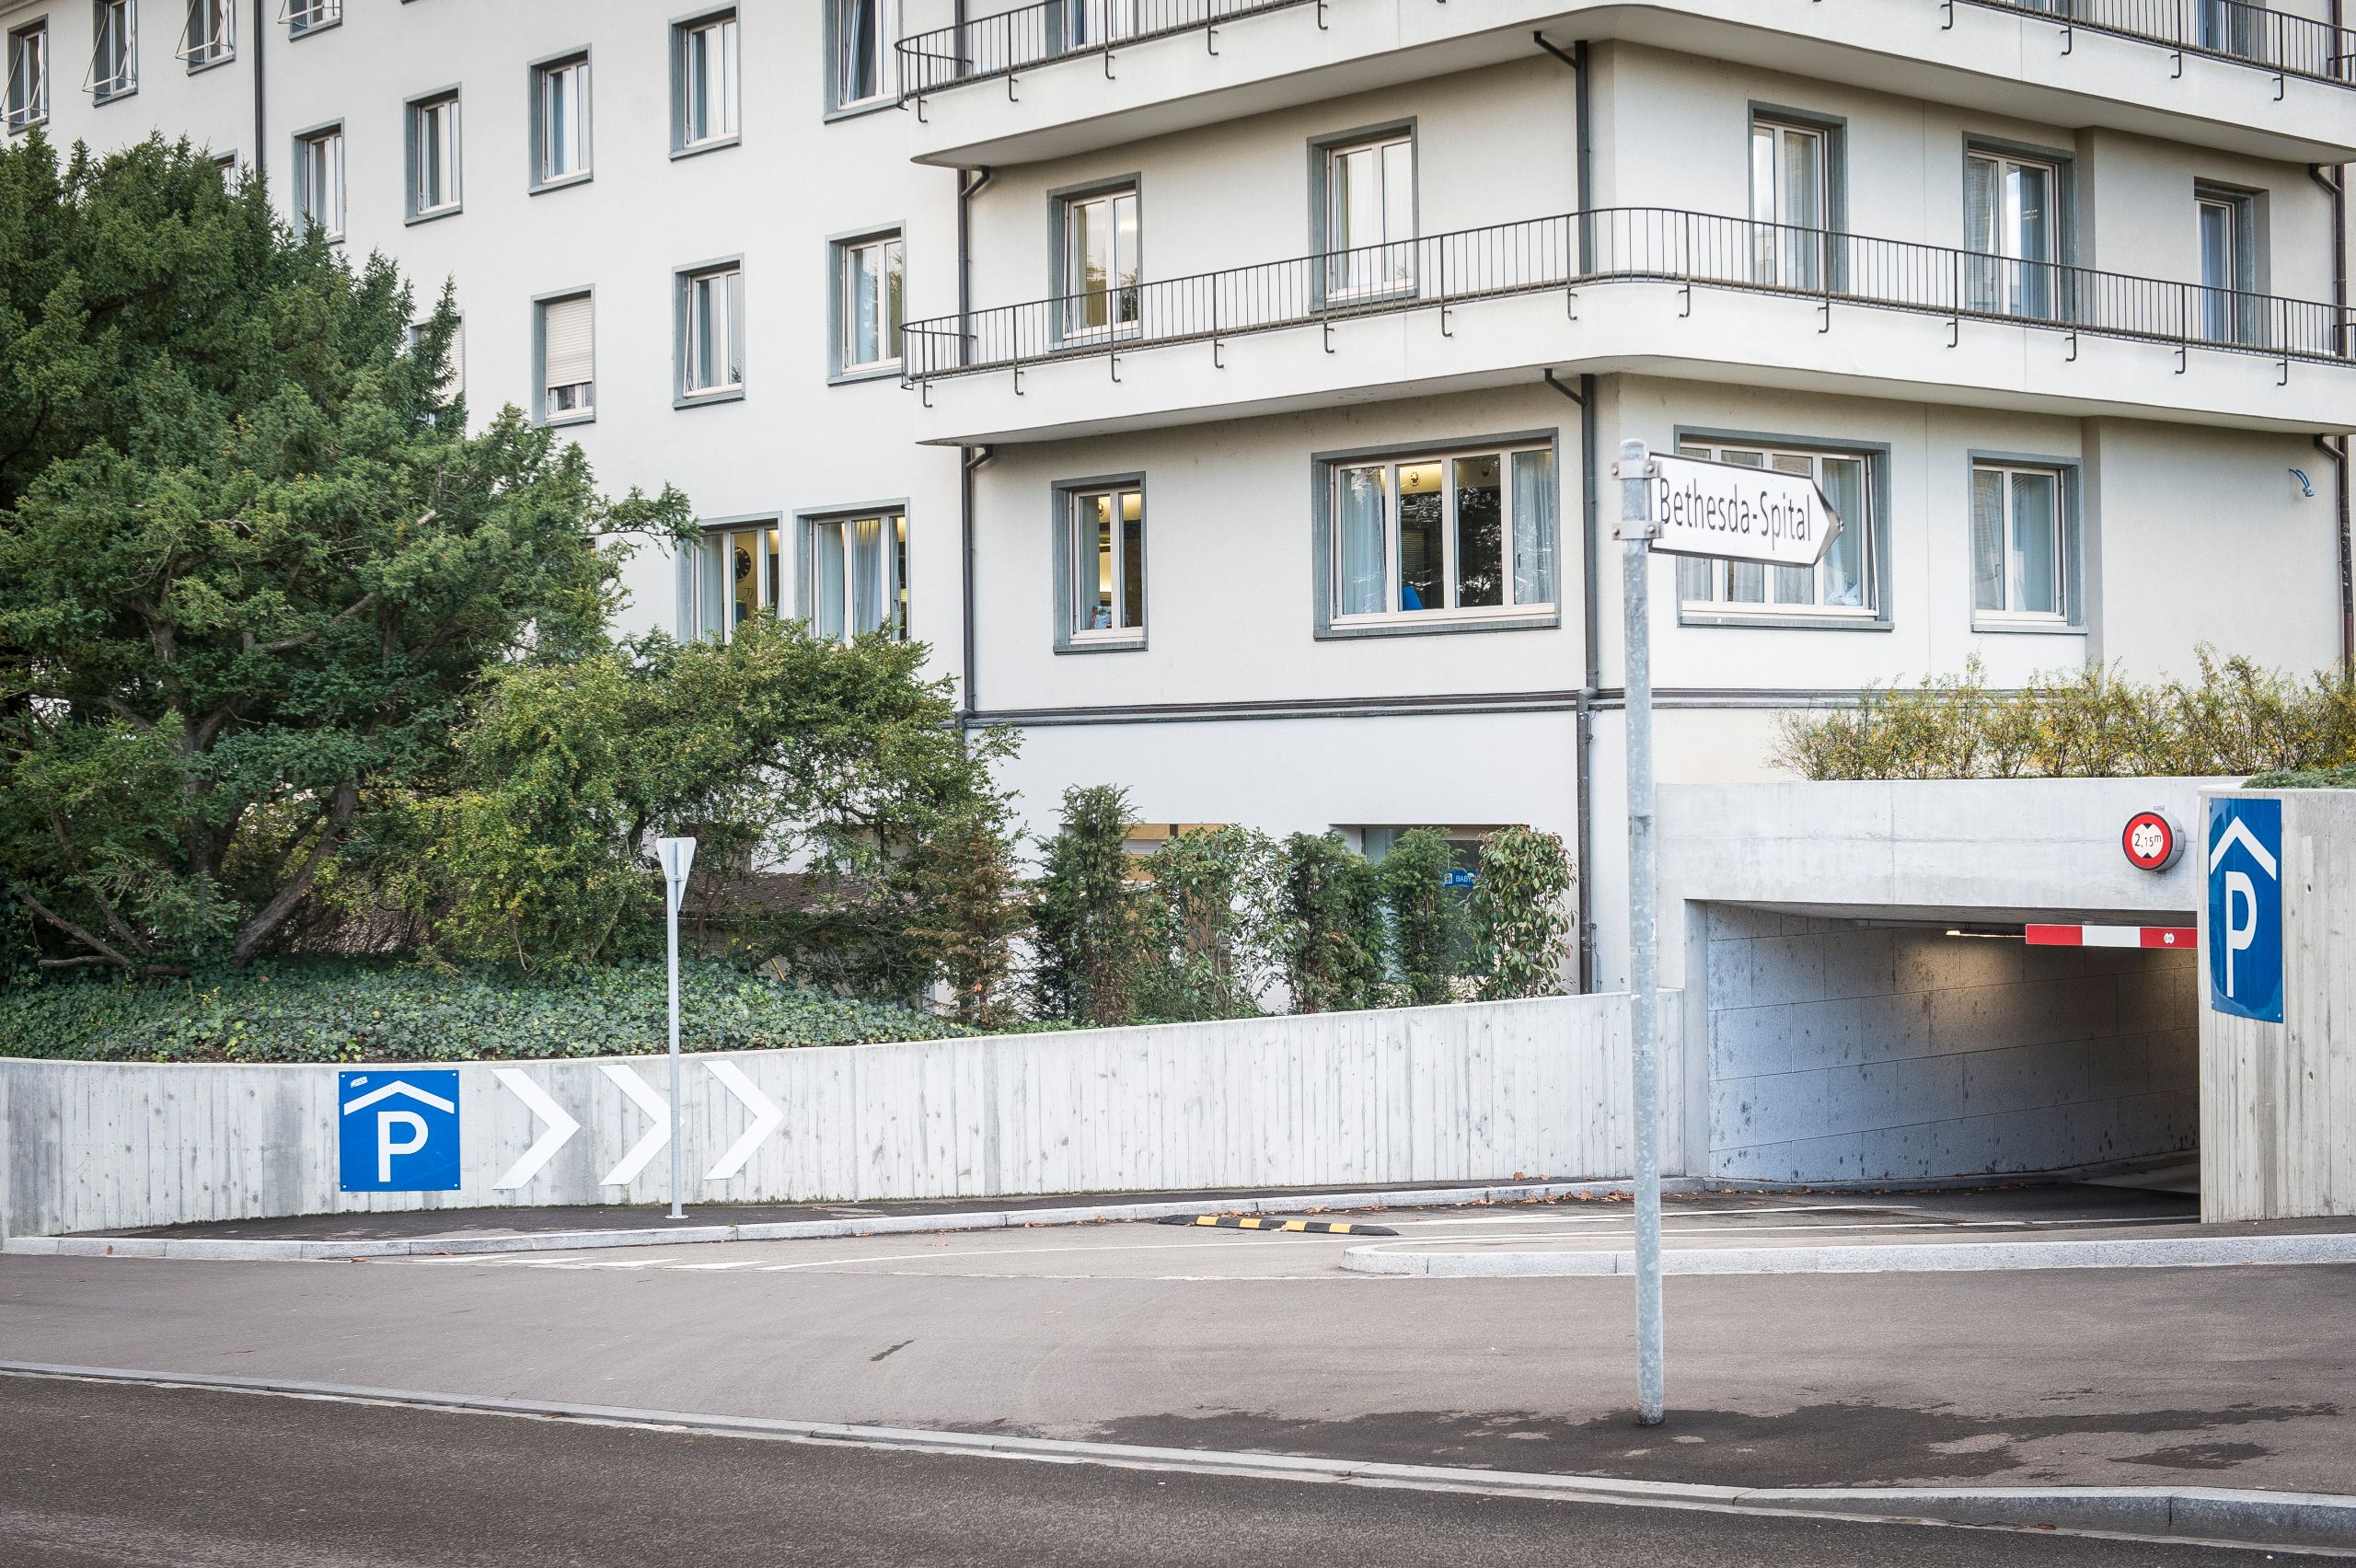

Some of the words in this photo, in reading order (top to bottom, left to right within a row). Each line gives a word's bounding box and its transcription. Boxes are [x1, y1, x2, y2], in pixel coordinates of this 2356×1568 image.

[1660, 478, 1811, 551] Bethesda-Spital
[2225, 870, 2258, 997] P
[377, 1111, 429, 1182] P
